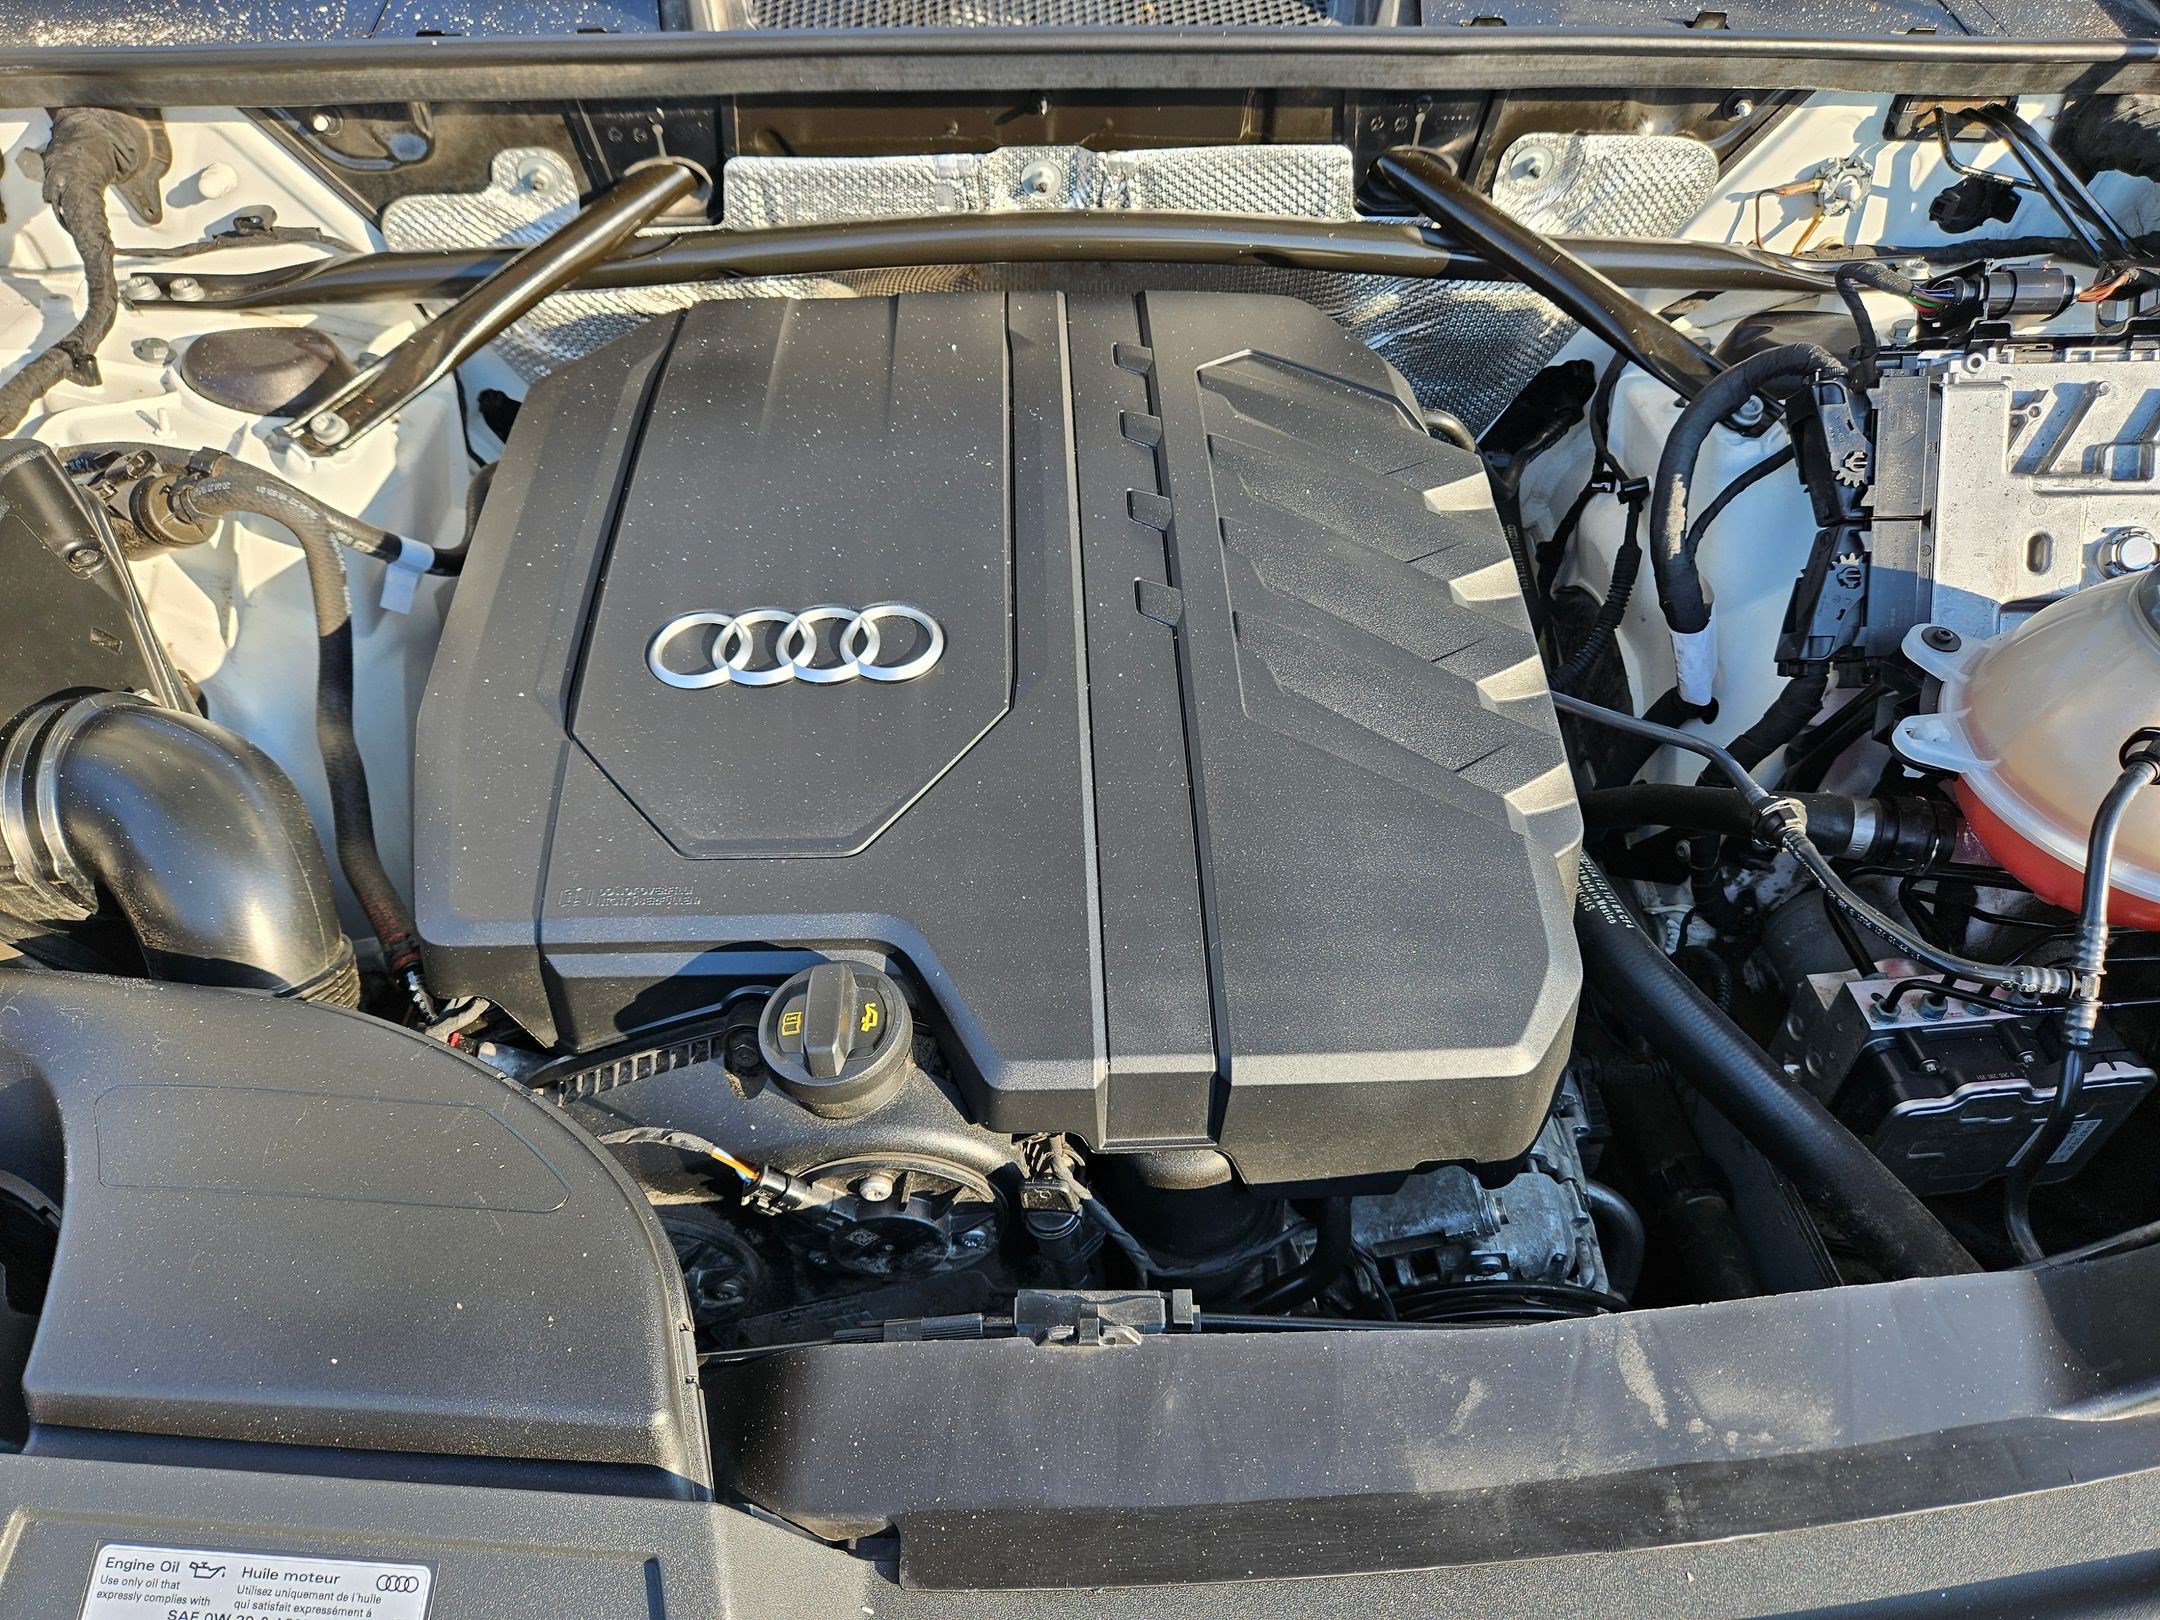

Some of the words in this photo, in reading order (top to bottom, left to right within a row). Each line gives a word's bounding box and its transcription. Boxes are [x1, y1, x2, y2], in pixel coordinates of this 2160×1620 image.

[1580, 874, 1596, 892] Made
[1596, 899, 1617, 924] Mexico
[105, 1556, 155, 1572] Engine
[160, 1560, 180, 1573] Oil
[100, 1574, 119, 1585] Use
[121, 1577, 143, 1588] only
[146, 1578, 158, 1588] oil
[161, 1580, 180, 1590] that
[242, 1566, 279, 1580] Huile
[283, 1572, 341, 1585] moteur
[96, 1590, 142, 1603] expressly
[144, 1592, 187, 1605] complies
[190, 1595, 211, 1606] with
[237, 1584, 272, 1597] Utilisez
[275, 1587, 334, 1601] uniquement
[336, 1591, 349, 1602] de
[234, 1600, 250, 1610] qui
[252, 1601, 291, 1613] satisfait
[293, 1604, 364, 1618] expressément
